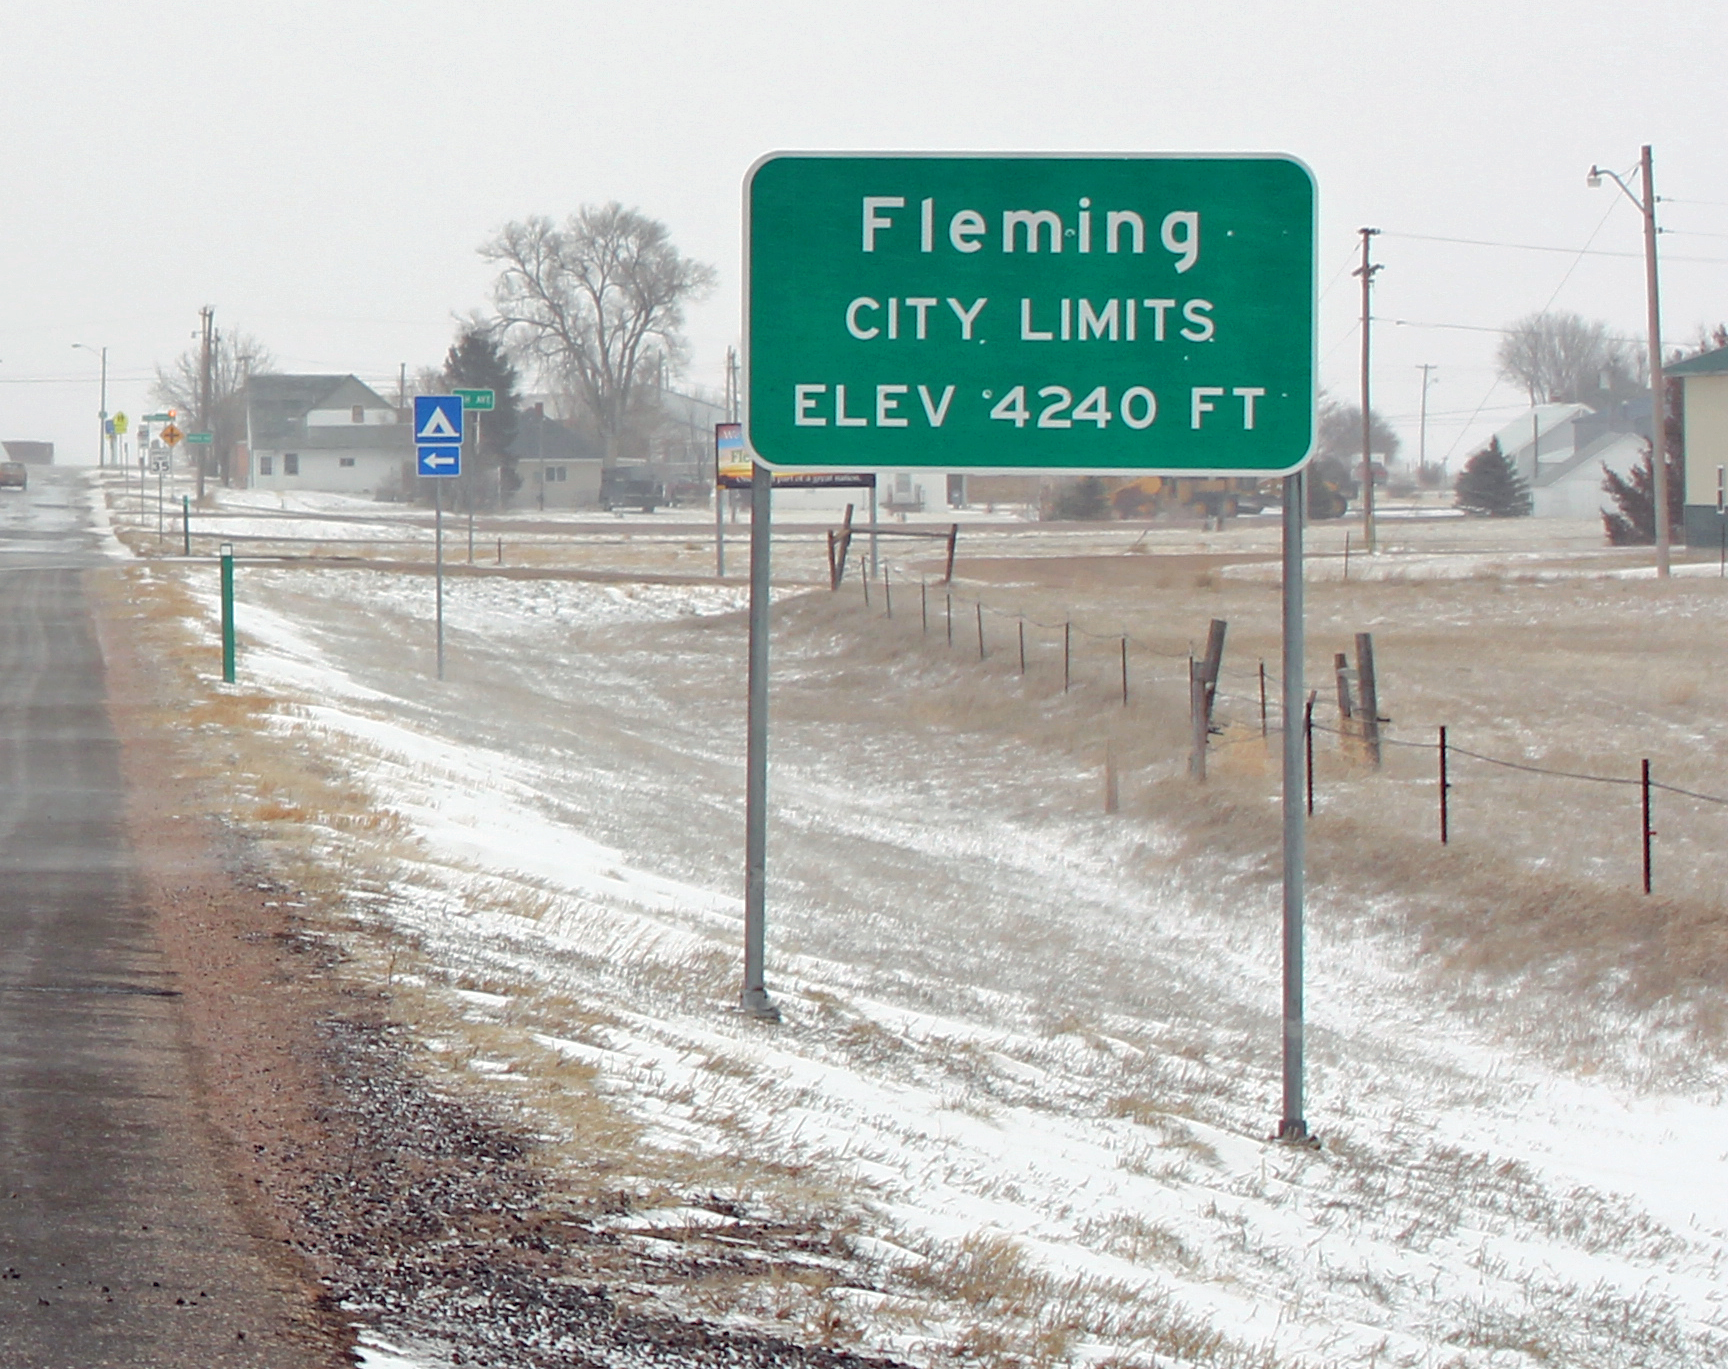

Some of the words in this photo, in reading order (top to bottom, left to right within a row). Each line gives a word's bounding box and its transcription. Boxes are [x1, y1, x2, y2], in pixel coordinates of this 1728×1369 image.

[861, 196, 1199, 274] Fleming
[845, 297, 988, 340] CITY
[1020, 298, 1215, 342] LIMITS
[794, 384, 955, 427] ELEV
[989, 385, 1157, 429] 4240
[1190, 387, 1265, 430] FT
[153, 461, 169, 471] 35
